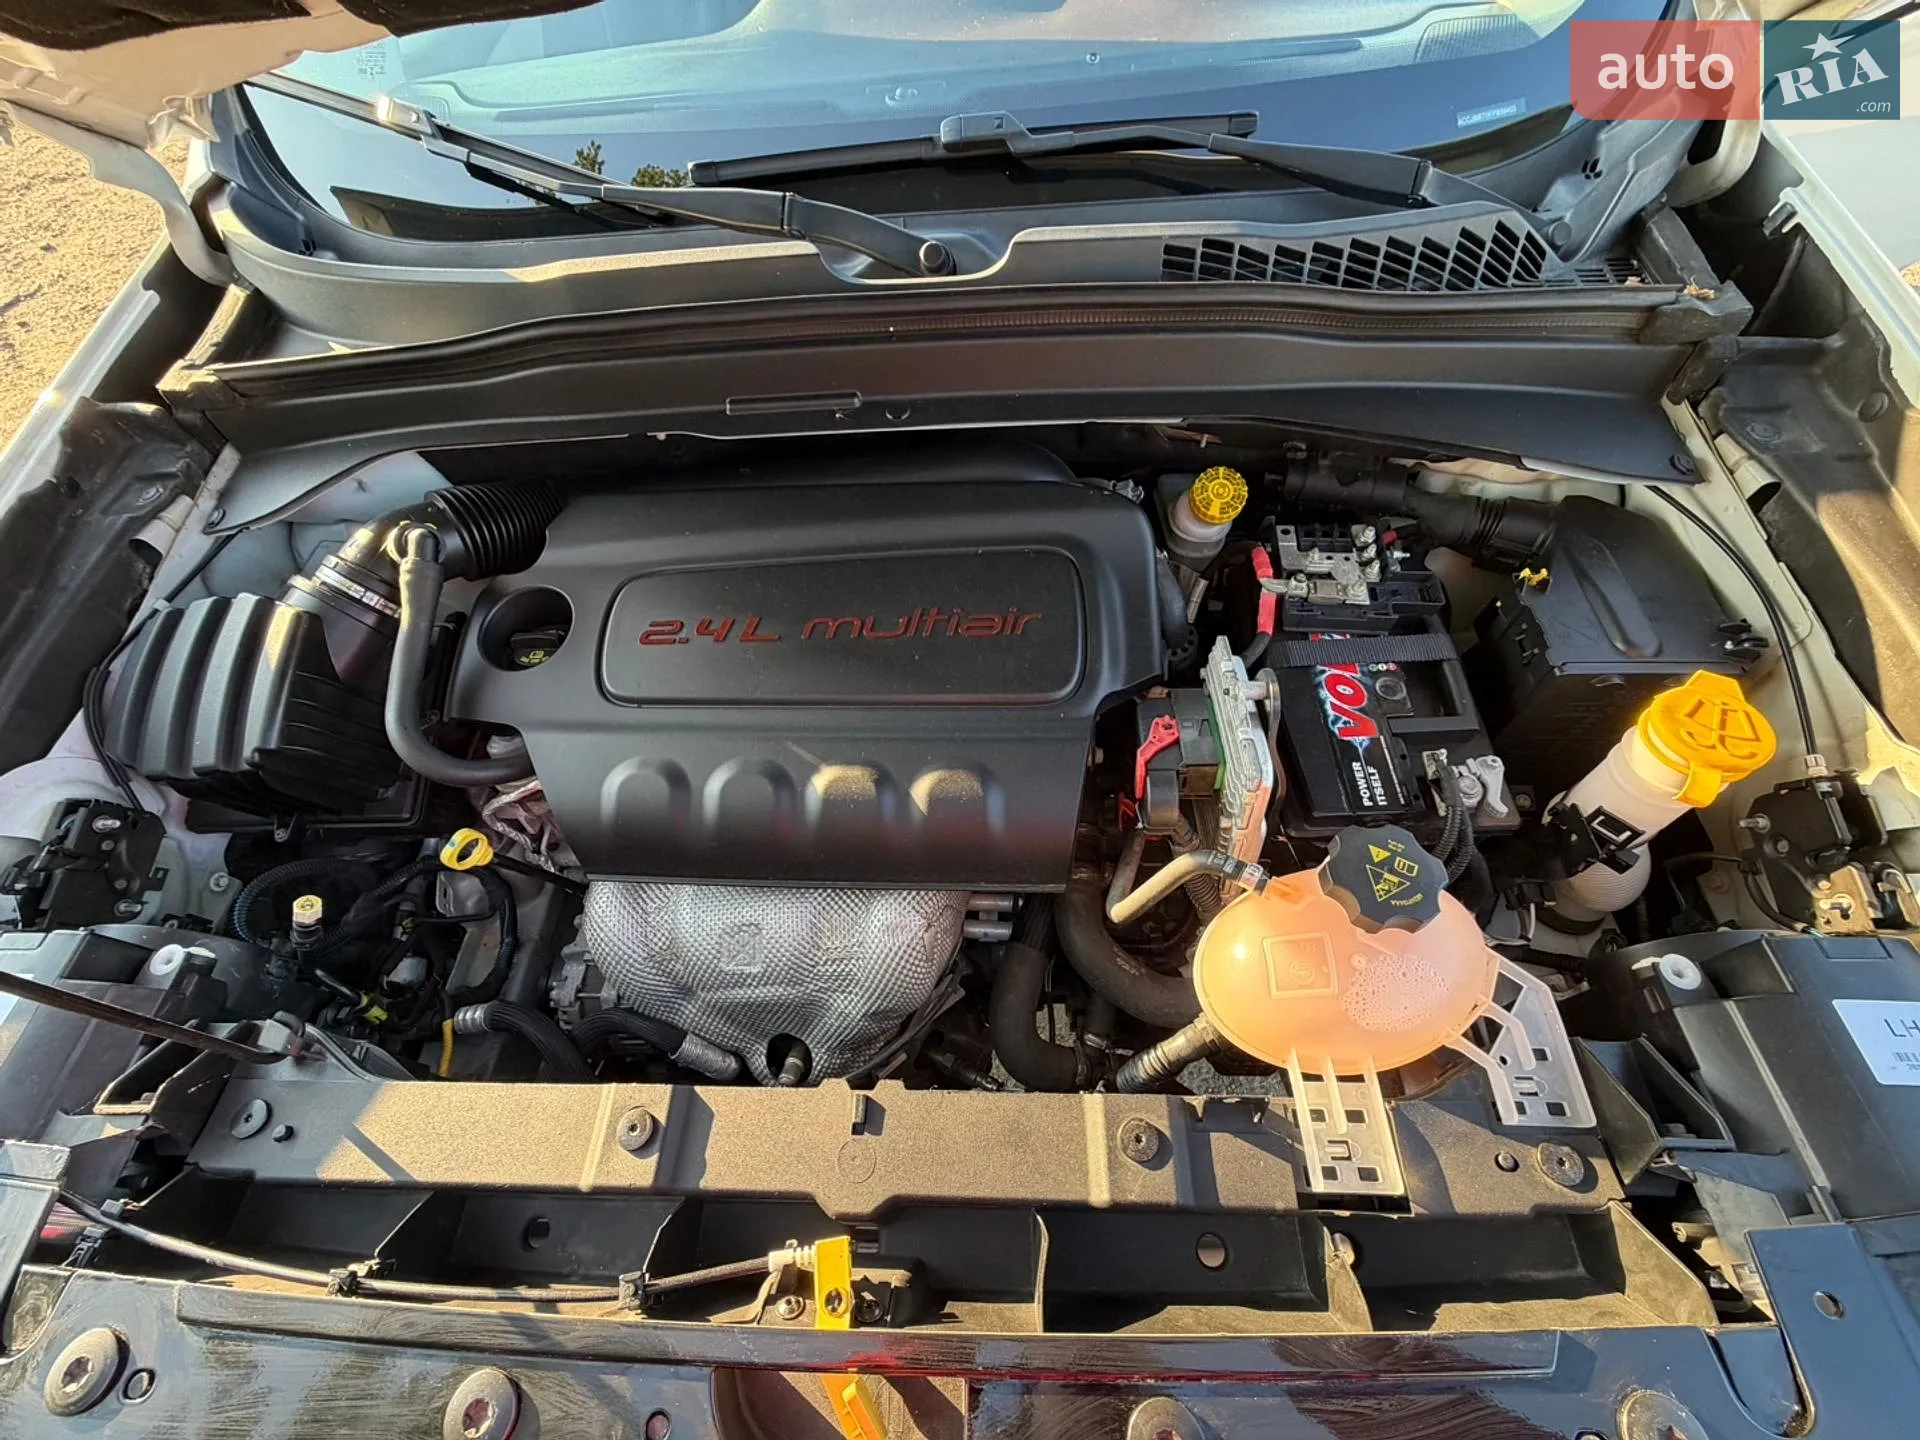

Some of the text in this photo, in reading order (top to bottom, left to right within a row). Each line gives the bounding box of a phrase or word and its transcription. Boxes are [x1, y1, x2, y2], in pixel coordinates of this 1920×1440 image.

[801, 605, 1042, 639] multiair
[1352, 761, 1373, 807] POWER
[1367, 765, 1388, 806] ITSELF
